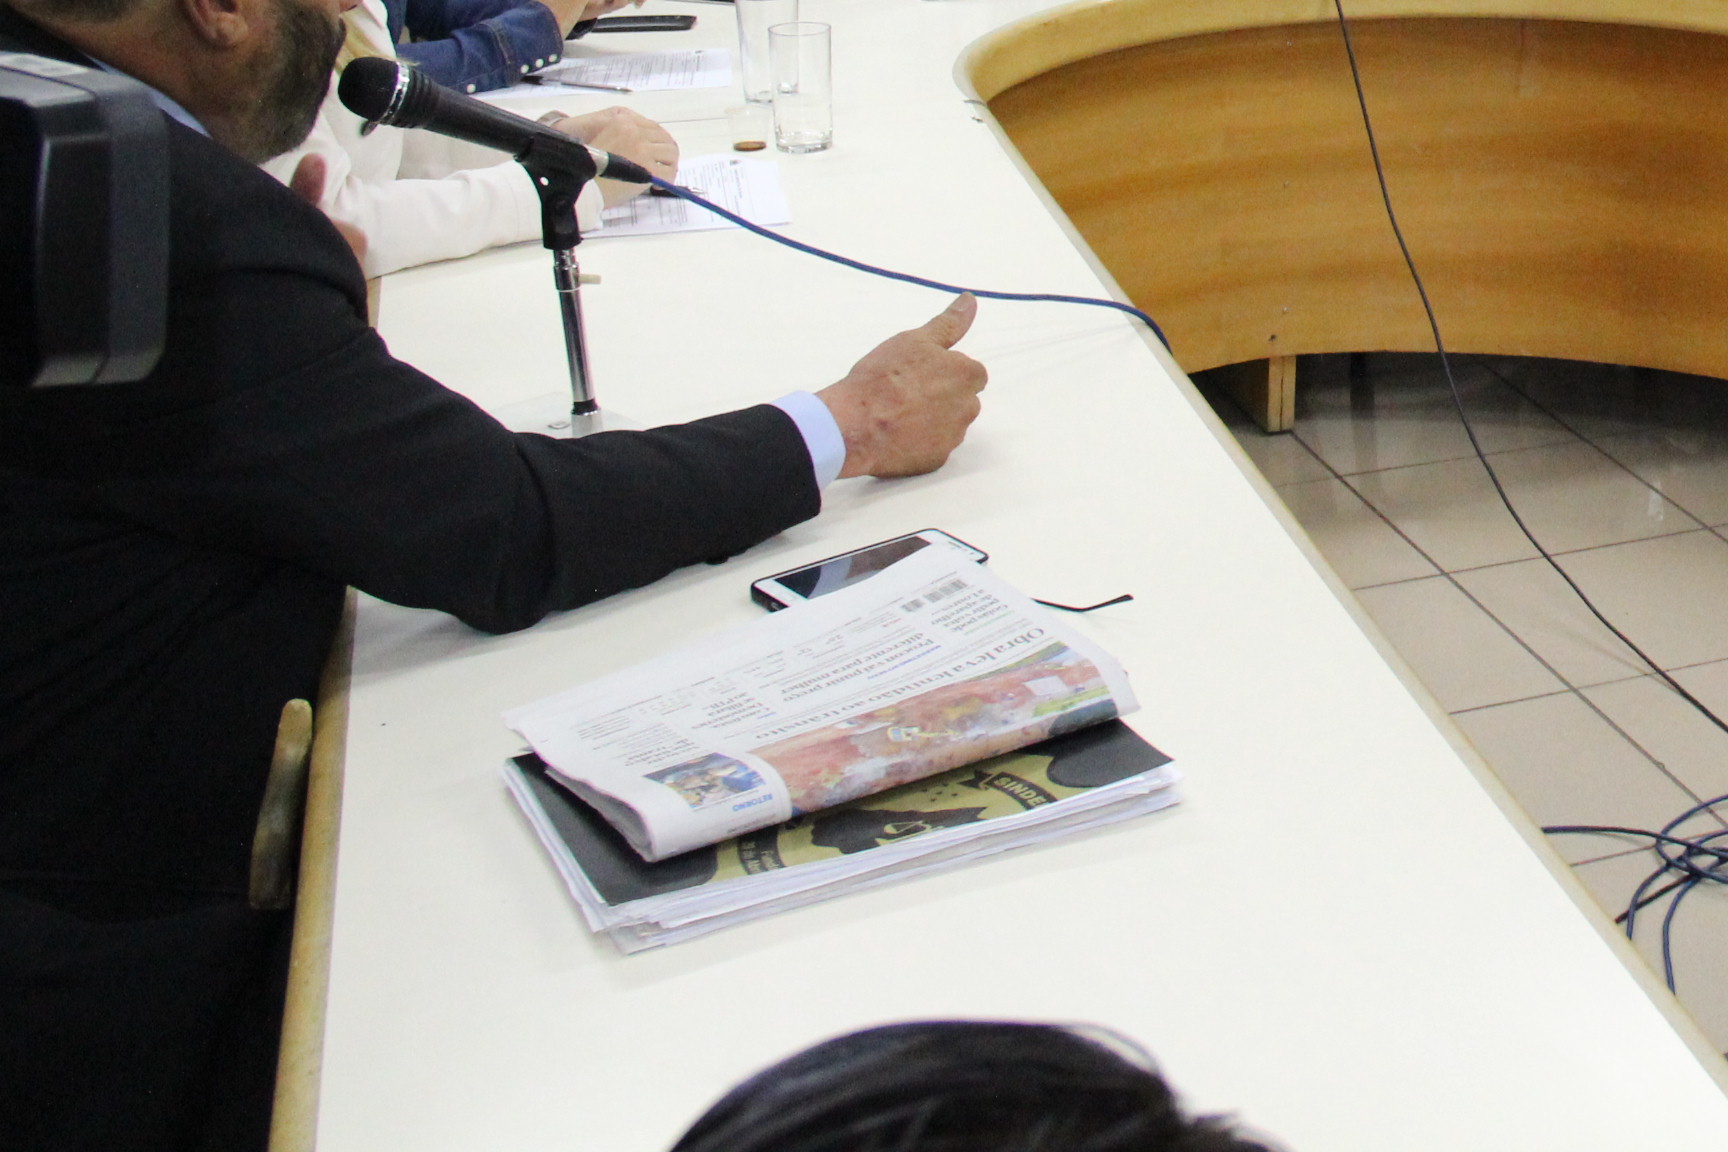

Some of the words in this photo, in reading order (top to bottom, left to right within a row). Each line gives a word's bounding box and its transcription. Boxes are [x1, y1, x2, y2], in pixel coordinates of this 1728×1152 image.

[861, 632, 927, 661] diferente
[883, 638, 935, 662] Procon
[992, 627, 1050, 654] Obra
[830, 658, 864, 674] para
[951, 651, 1000, 673] leva
[778, 672, 833, 694] mulher
[825, 668, 864, 686] punir
[865, 670, 955, 703] lentidão
[780, 683, 824, 701] preço
[838, 700, 868, 711] ao
[754, 710, 841, 740] trânsito
[732, 793, 774, 812] RETORNO
